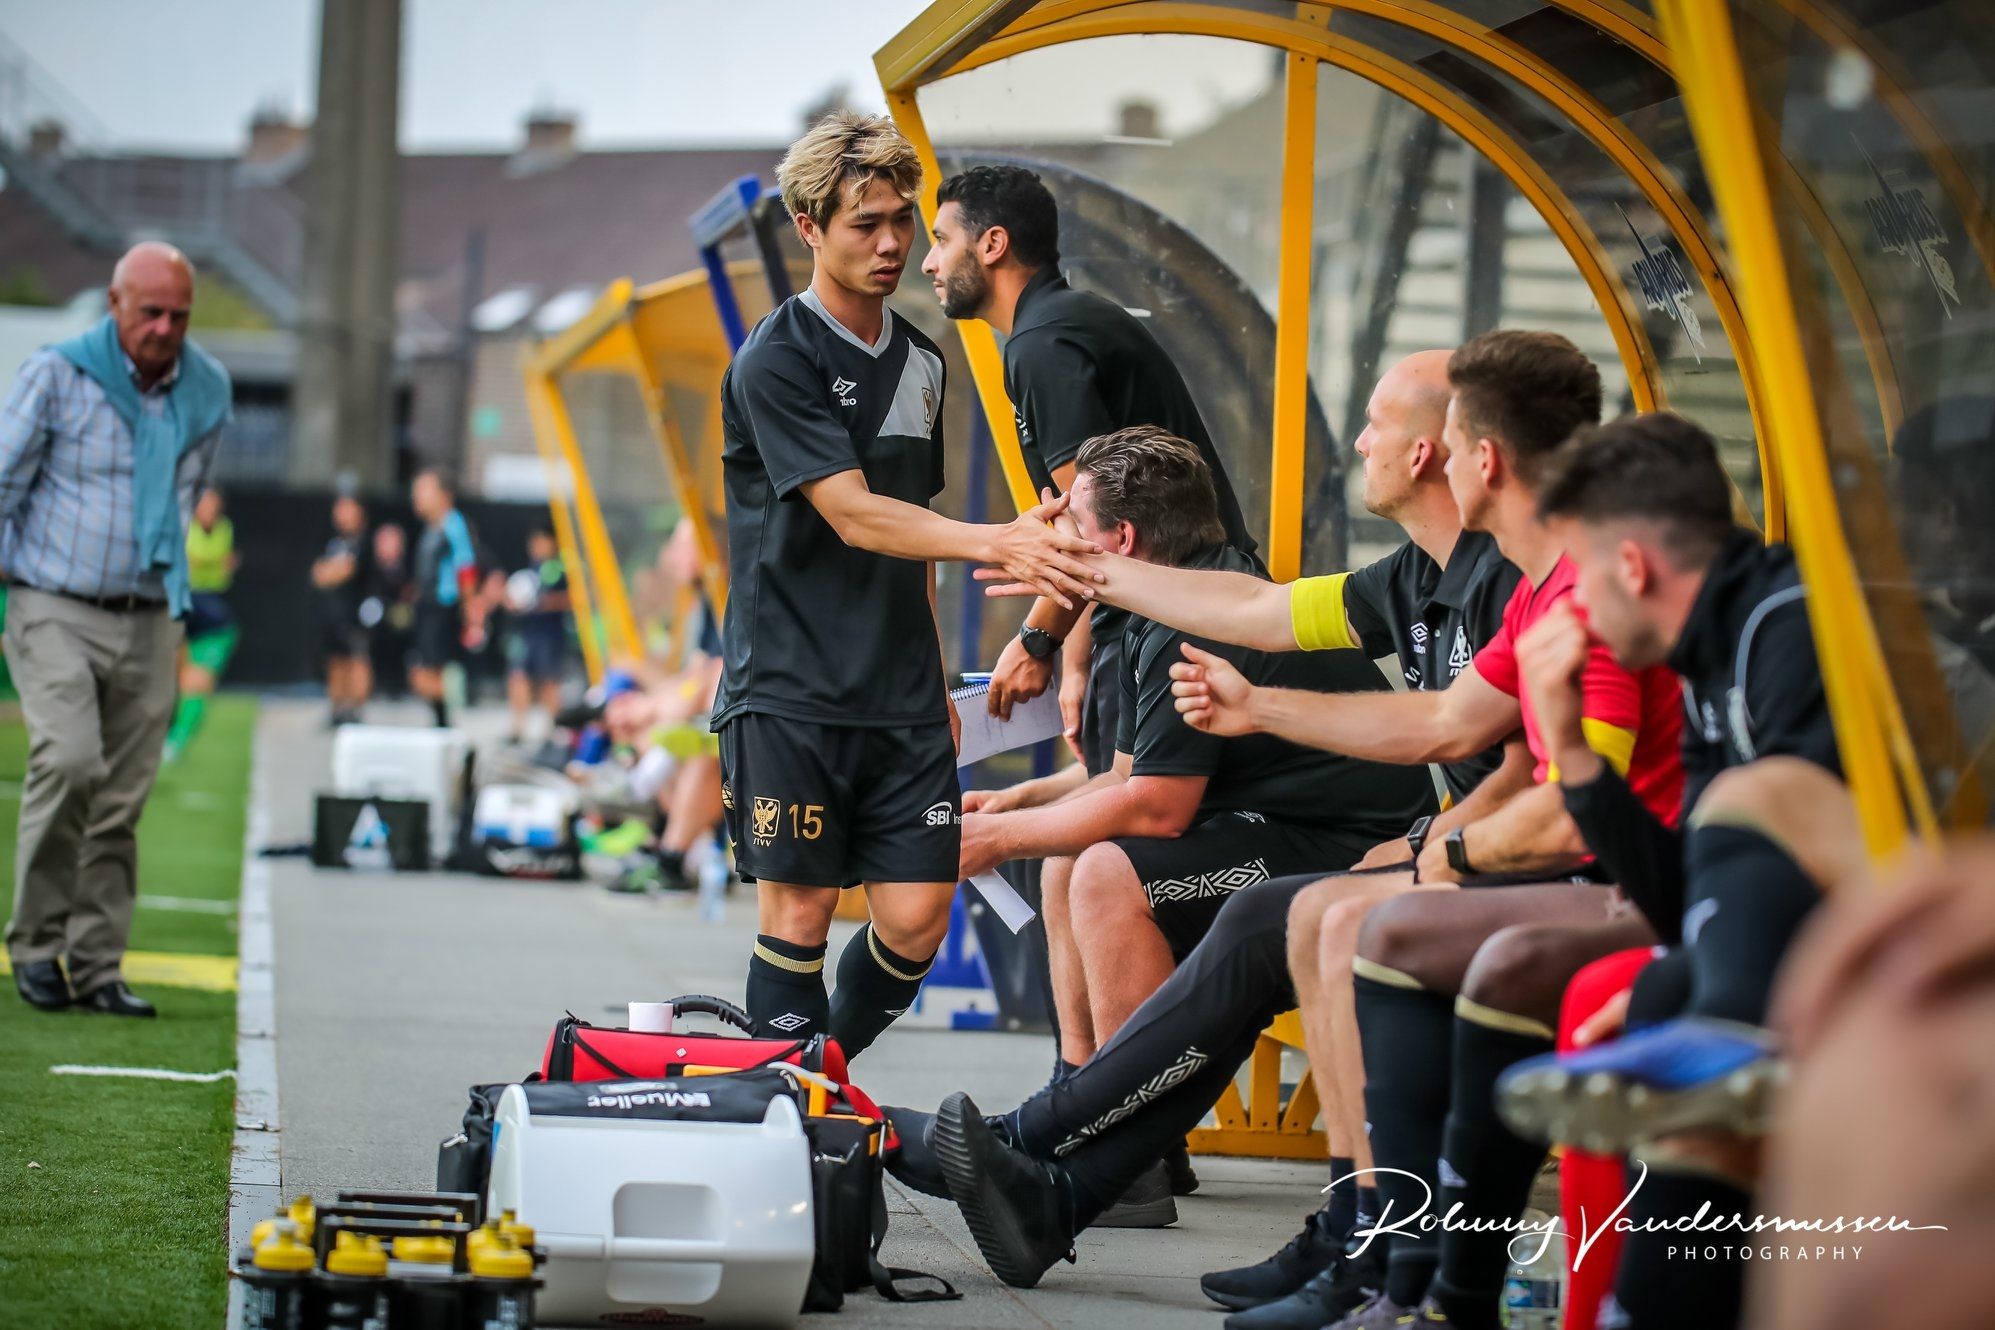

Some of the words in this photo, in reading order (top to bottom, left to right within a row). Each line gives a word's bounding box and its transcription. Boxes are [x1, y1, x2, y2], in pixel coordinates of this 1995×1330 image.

[788, 804, 824, 840] 15
[926, 810, 950, 826] SBI
[587, 1092, 711, 1109] Mueller
